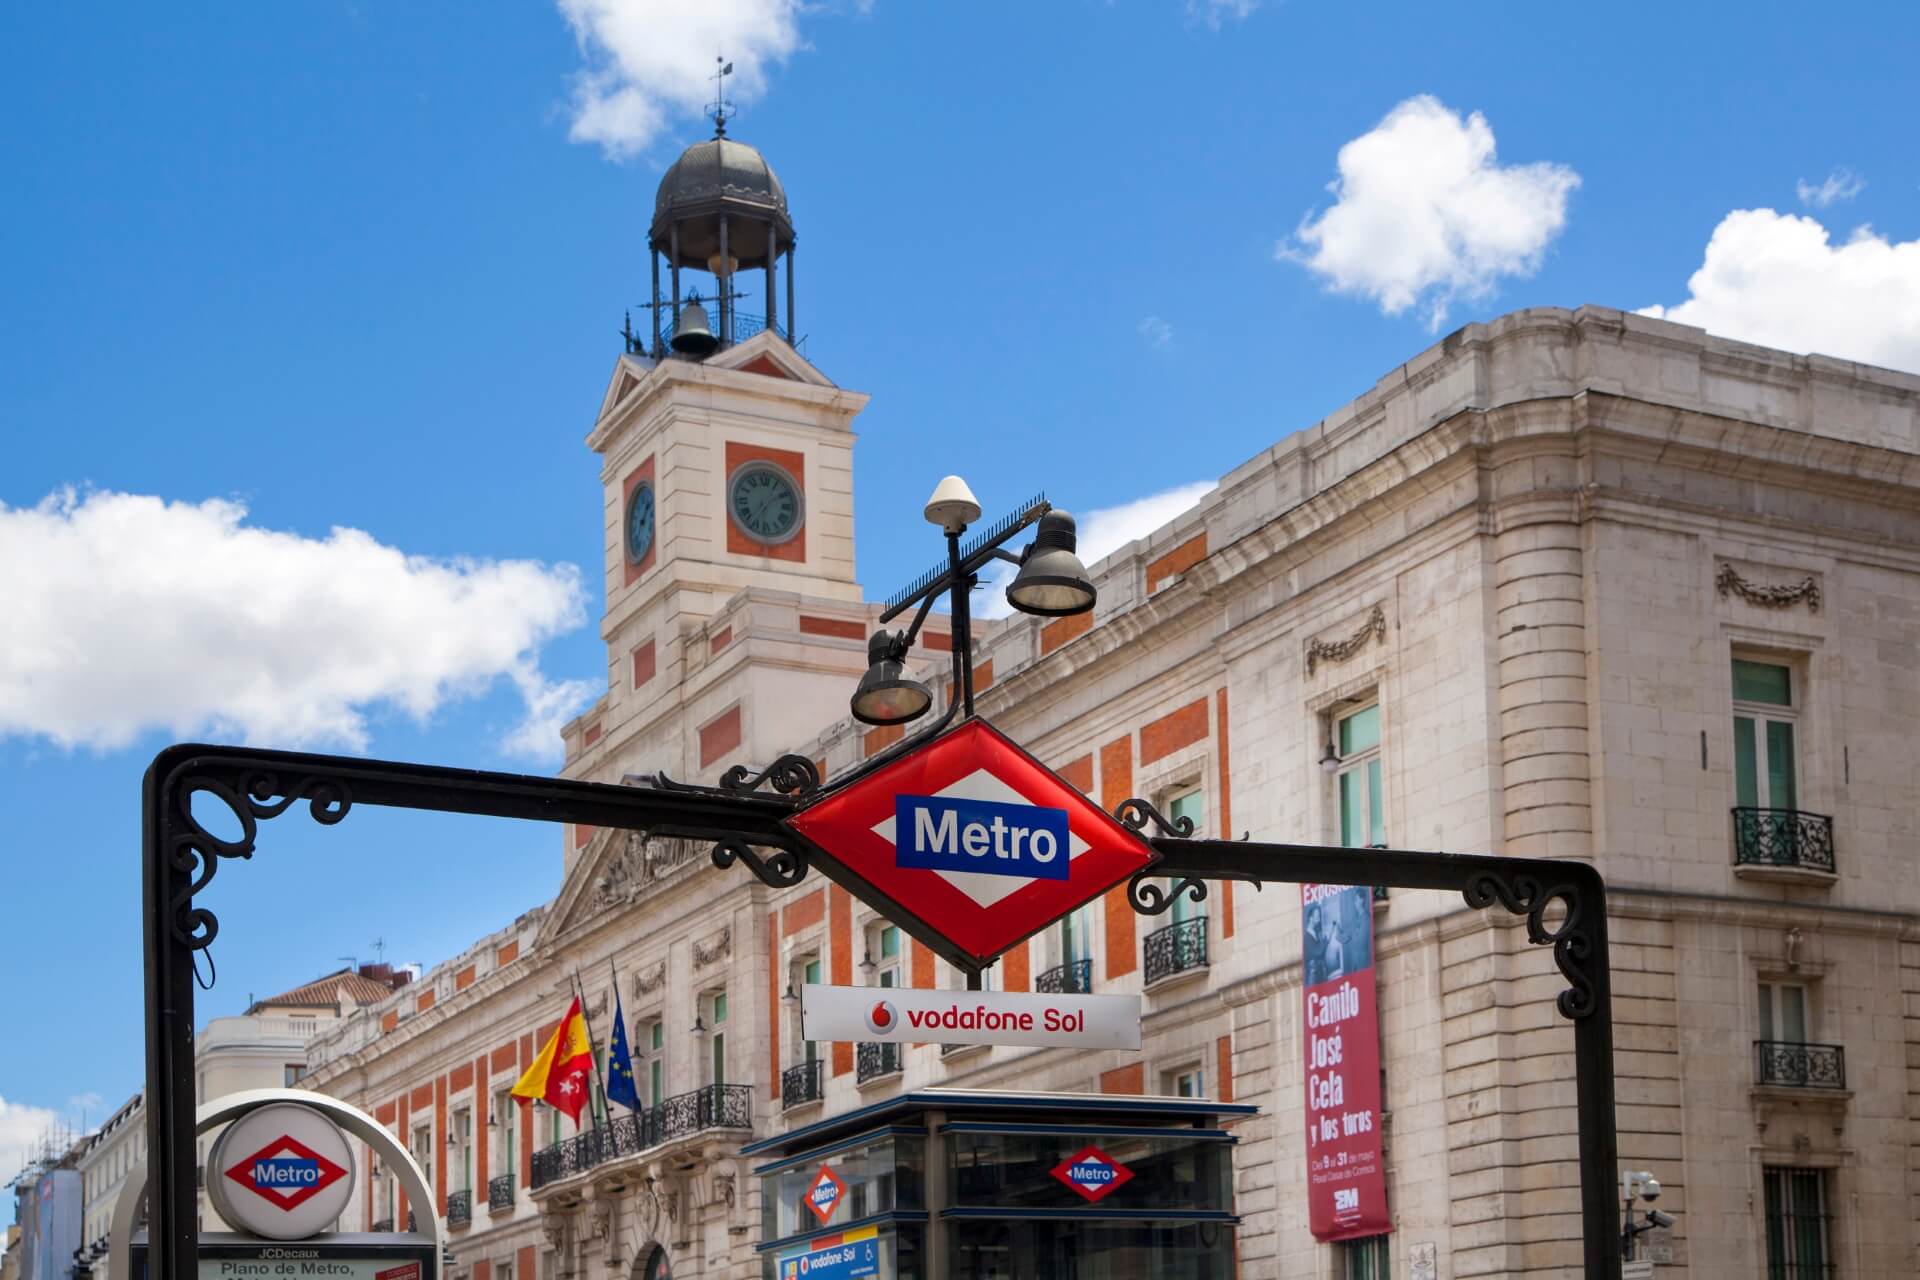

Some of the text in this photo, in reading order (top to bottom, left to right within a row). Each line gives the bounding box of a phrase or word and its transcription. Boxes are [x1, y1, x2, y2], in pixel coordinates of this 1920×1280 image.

[914, 807, 1057, 863] Metro
[1307, 981, 1359, 1029] Camilo
[907, 1006, 1084, 1032] vodafone Sol
[1309, 1026, 1343, 1070] José
[1310, 1070, 1344, 1111] Cela
[1311, 1110, 1373, 1147] y los toros
[1337, 1151, 1348, 1166] 31
[255, 1163, 316, 1183] Metro
[1073, 1167, 1111, 1181] Metro
[814, 1186, 835, 1202] Metro
[259, 1248, 320, 1259] JCDecaux
[810, 1252, 842, 1270] vodafone
[843, 1247, 855, 1262] Sol
[221, 1262, 354, 1276] Plano de Metro,
